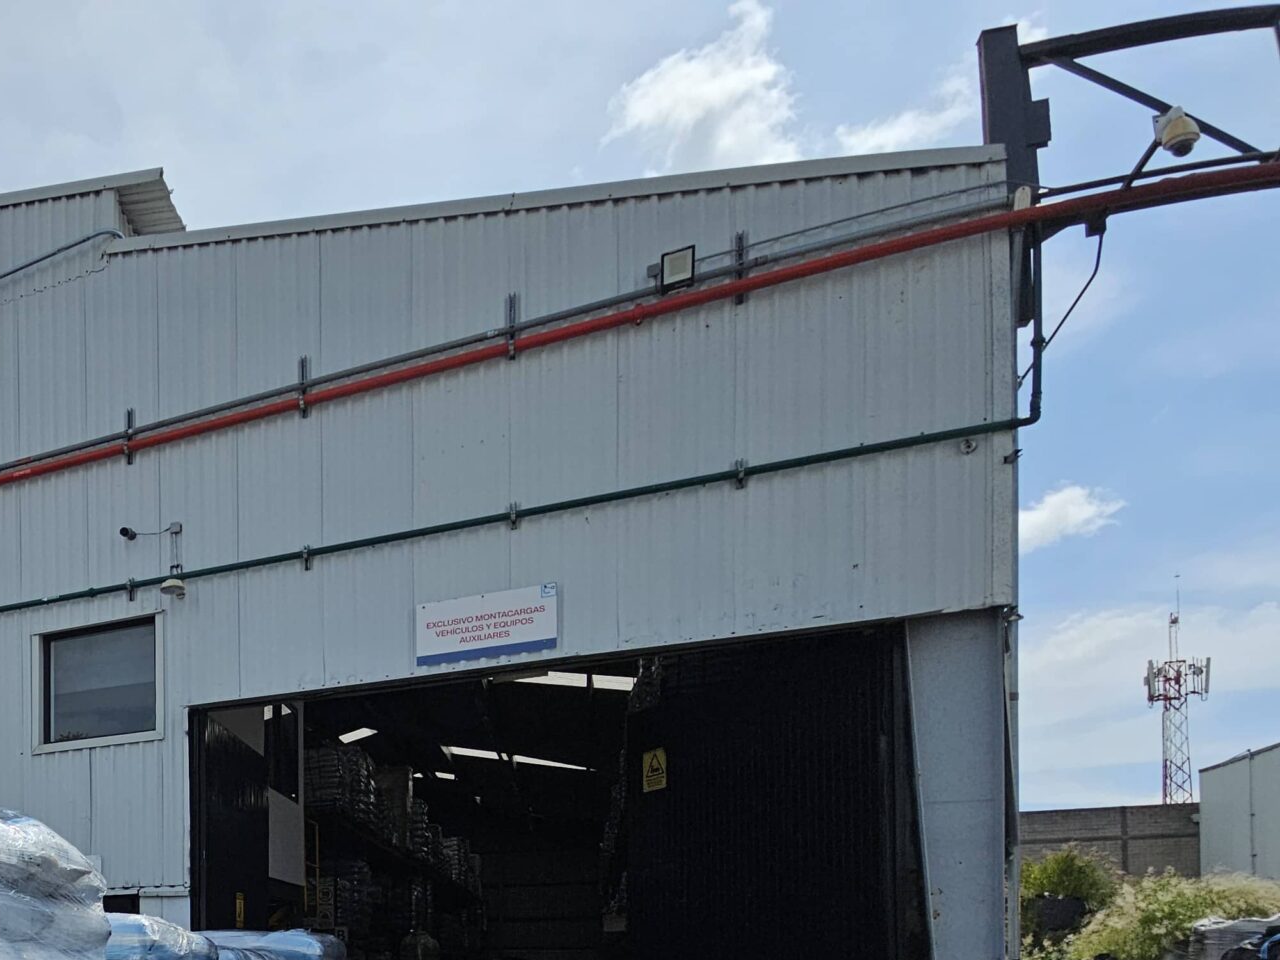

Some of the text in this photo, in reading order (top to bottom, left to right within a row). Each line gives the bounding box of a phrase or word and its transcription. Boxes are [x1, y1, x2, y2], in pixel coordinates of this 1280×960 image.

[426, 605, 546, 630] EXCLUSIVO MONTACARGAS
[493, 617, 534, 629] EQUIPOS
[459, 630, 510, 644] AUXILIARES
